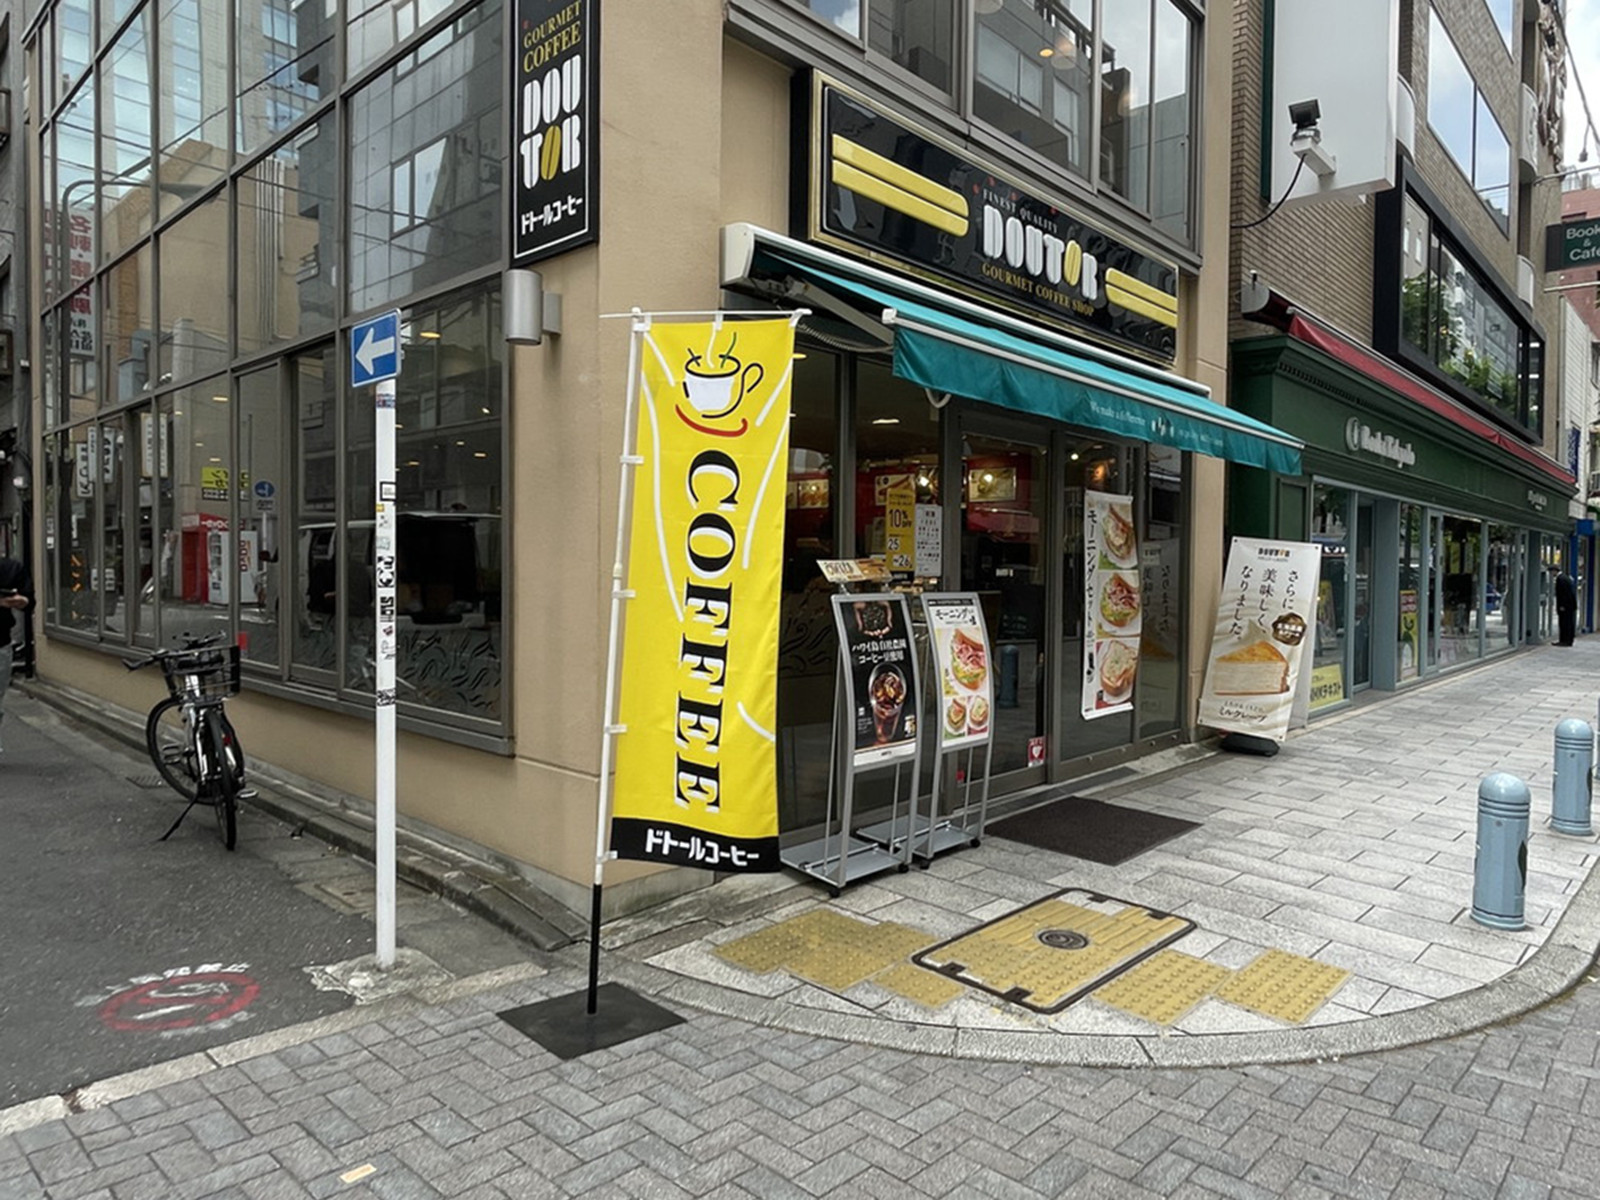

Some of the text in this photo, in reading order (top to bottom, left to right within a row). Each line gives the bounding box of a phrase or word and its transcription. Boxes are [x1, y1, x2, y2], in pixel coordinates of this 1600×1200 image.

[523, 1, 581, 49] GOURMET
[523, 21, 581, 73] COFFEE
[521, 194, 583, 235] ドトールコーヒー
[983, 188, 1058, 234] FINEST QUALITY
[983, 204, 1098, 301] DOUTOR
[1583, 238, 1592, 247] &
[982, 263, 1095, 317] GOURMET COFFEE SHOP
[888, 538, 900, 551] 25
[1282, 570, 1299, 610] さらに
[674, 449, 740, 814] COFFEE
[645, 828, 760, 867] ドトールコーヒー
